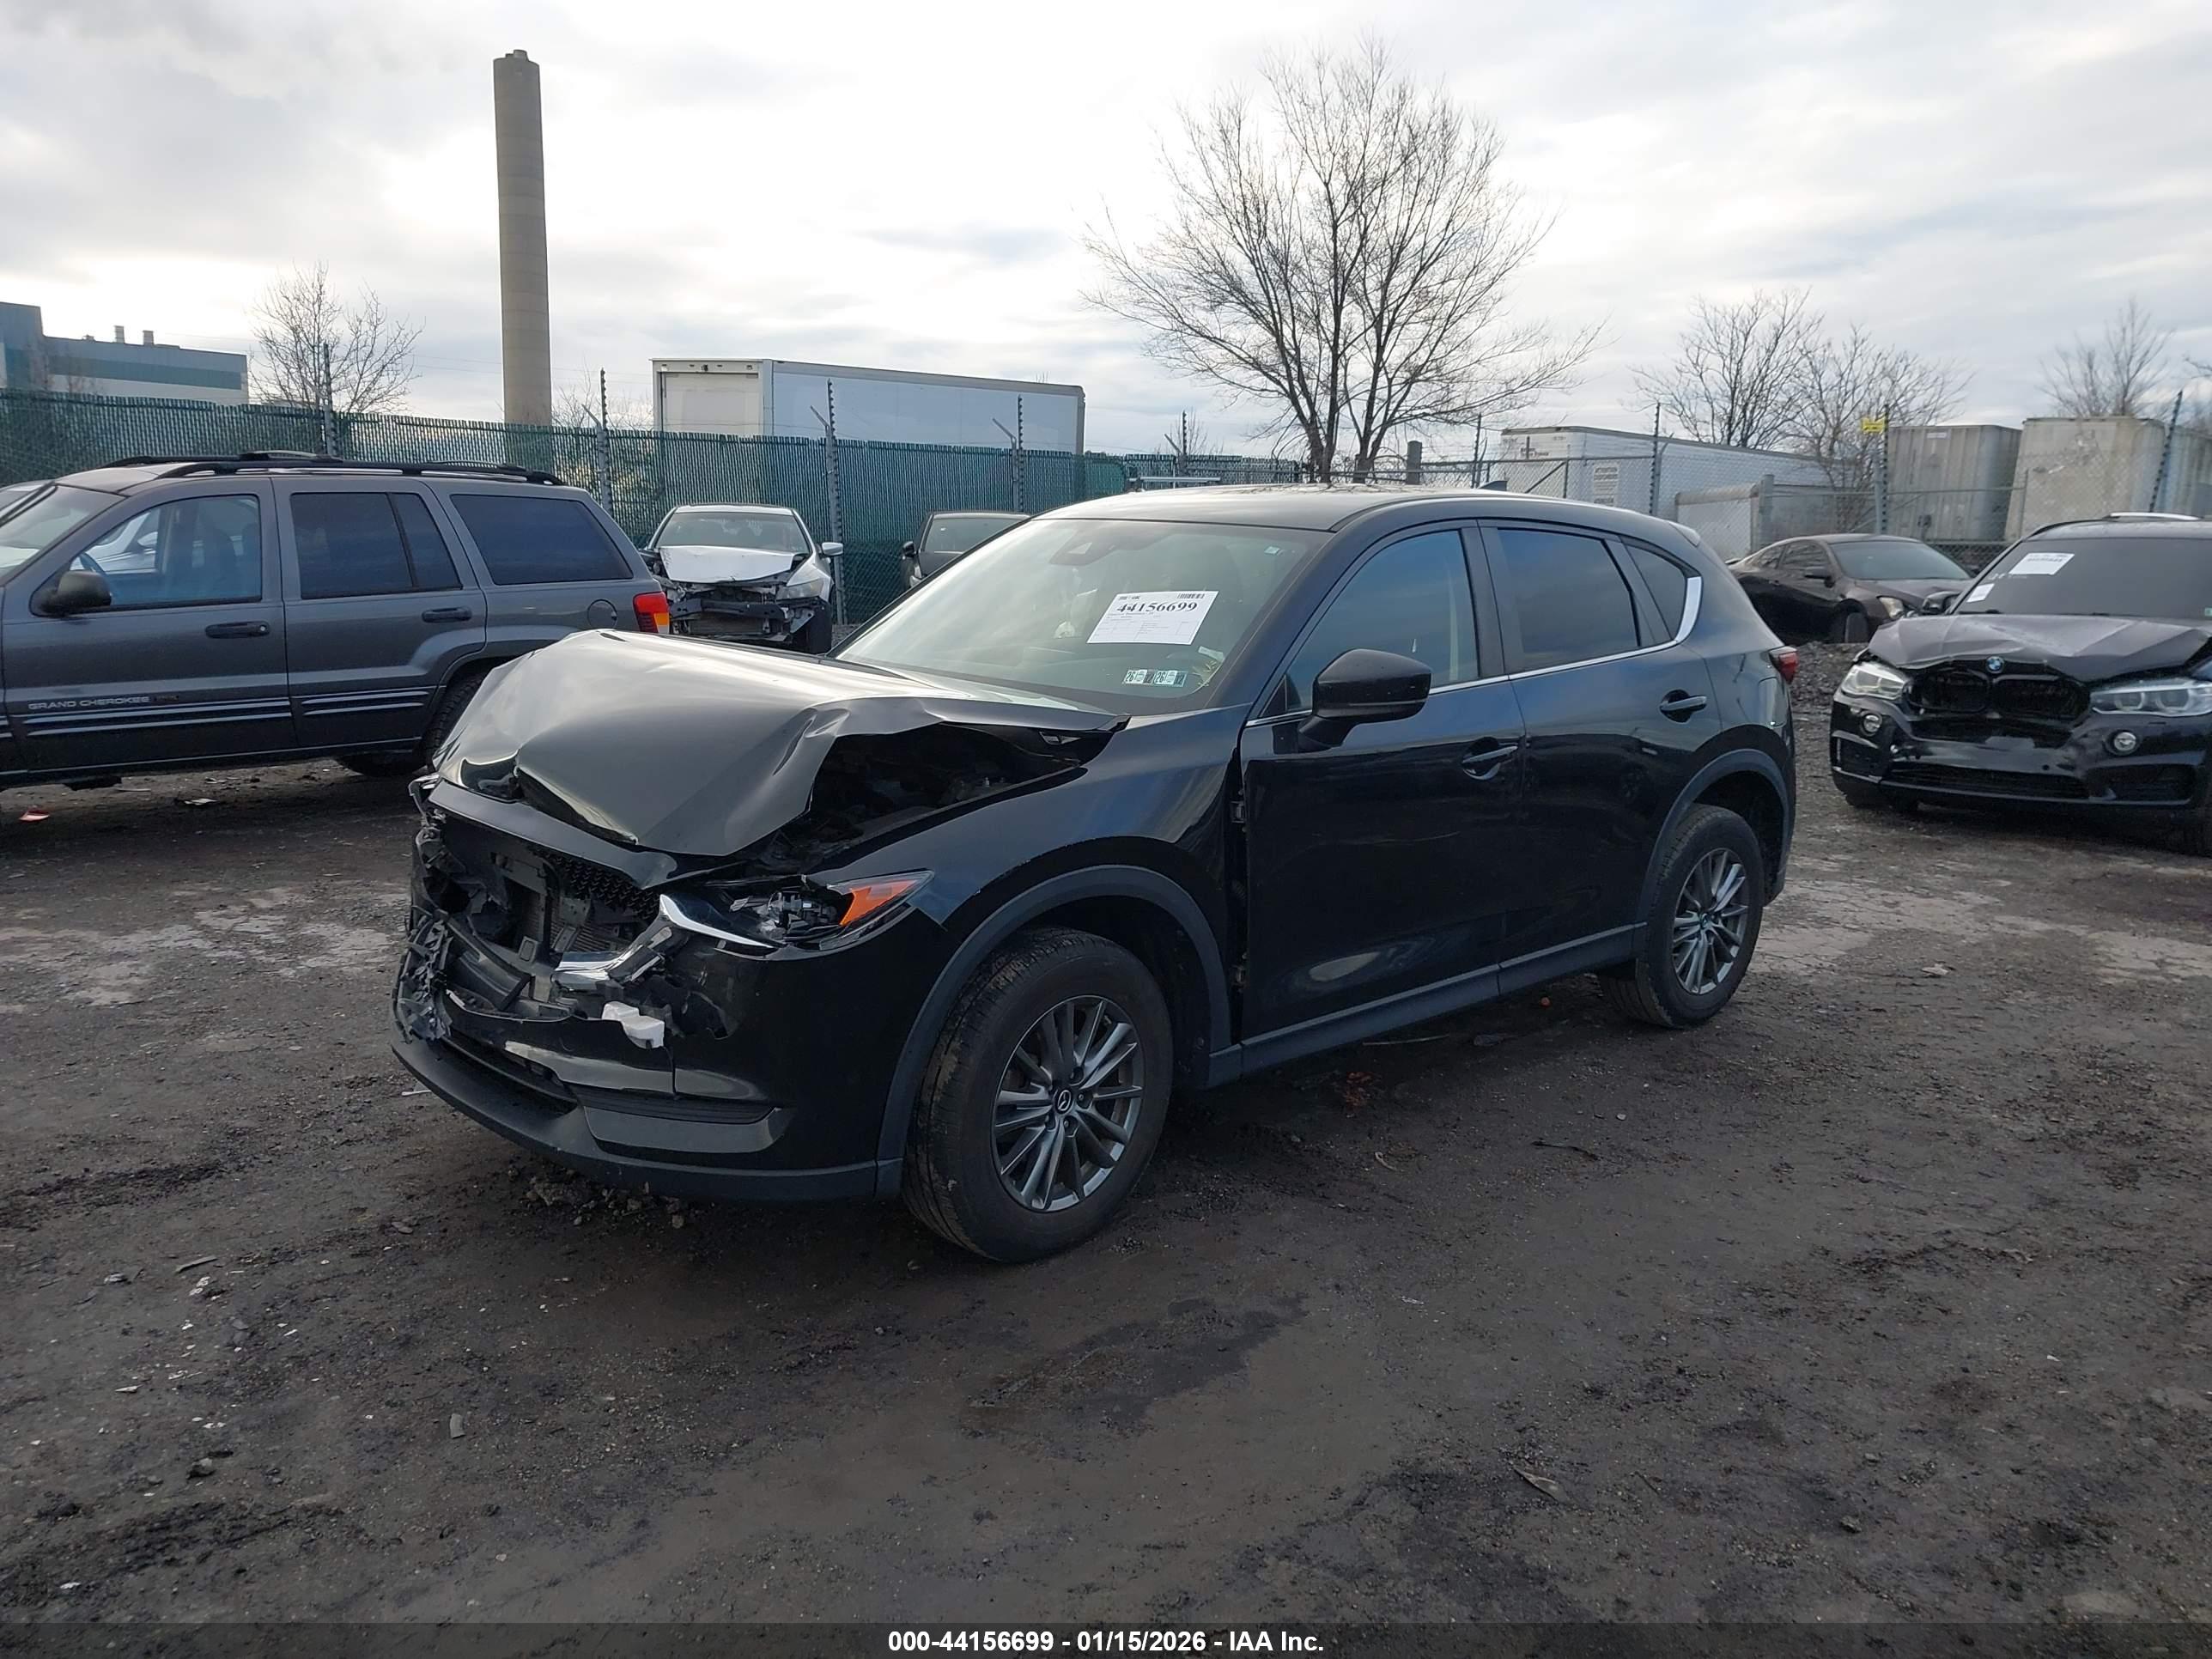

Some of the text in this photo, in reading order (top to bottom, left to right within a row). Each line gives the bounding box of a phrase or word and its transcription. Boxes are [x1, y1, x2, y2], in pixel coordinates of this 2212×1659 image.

[1117, 602, 1198, 612] 44156699
[1126, 671, 1136, 682] 26
[1156, 672, 1166, 683] 26
[28, 700, 77, 710] GRAND
[79, 696, 150, 707] CHEROKEE
